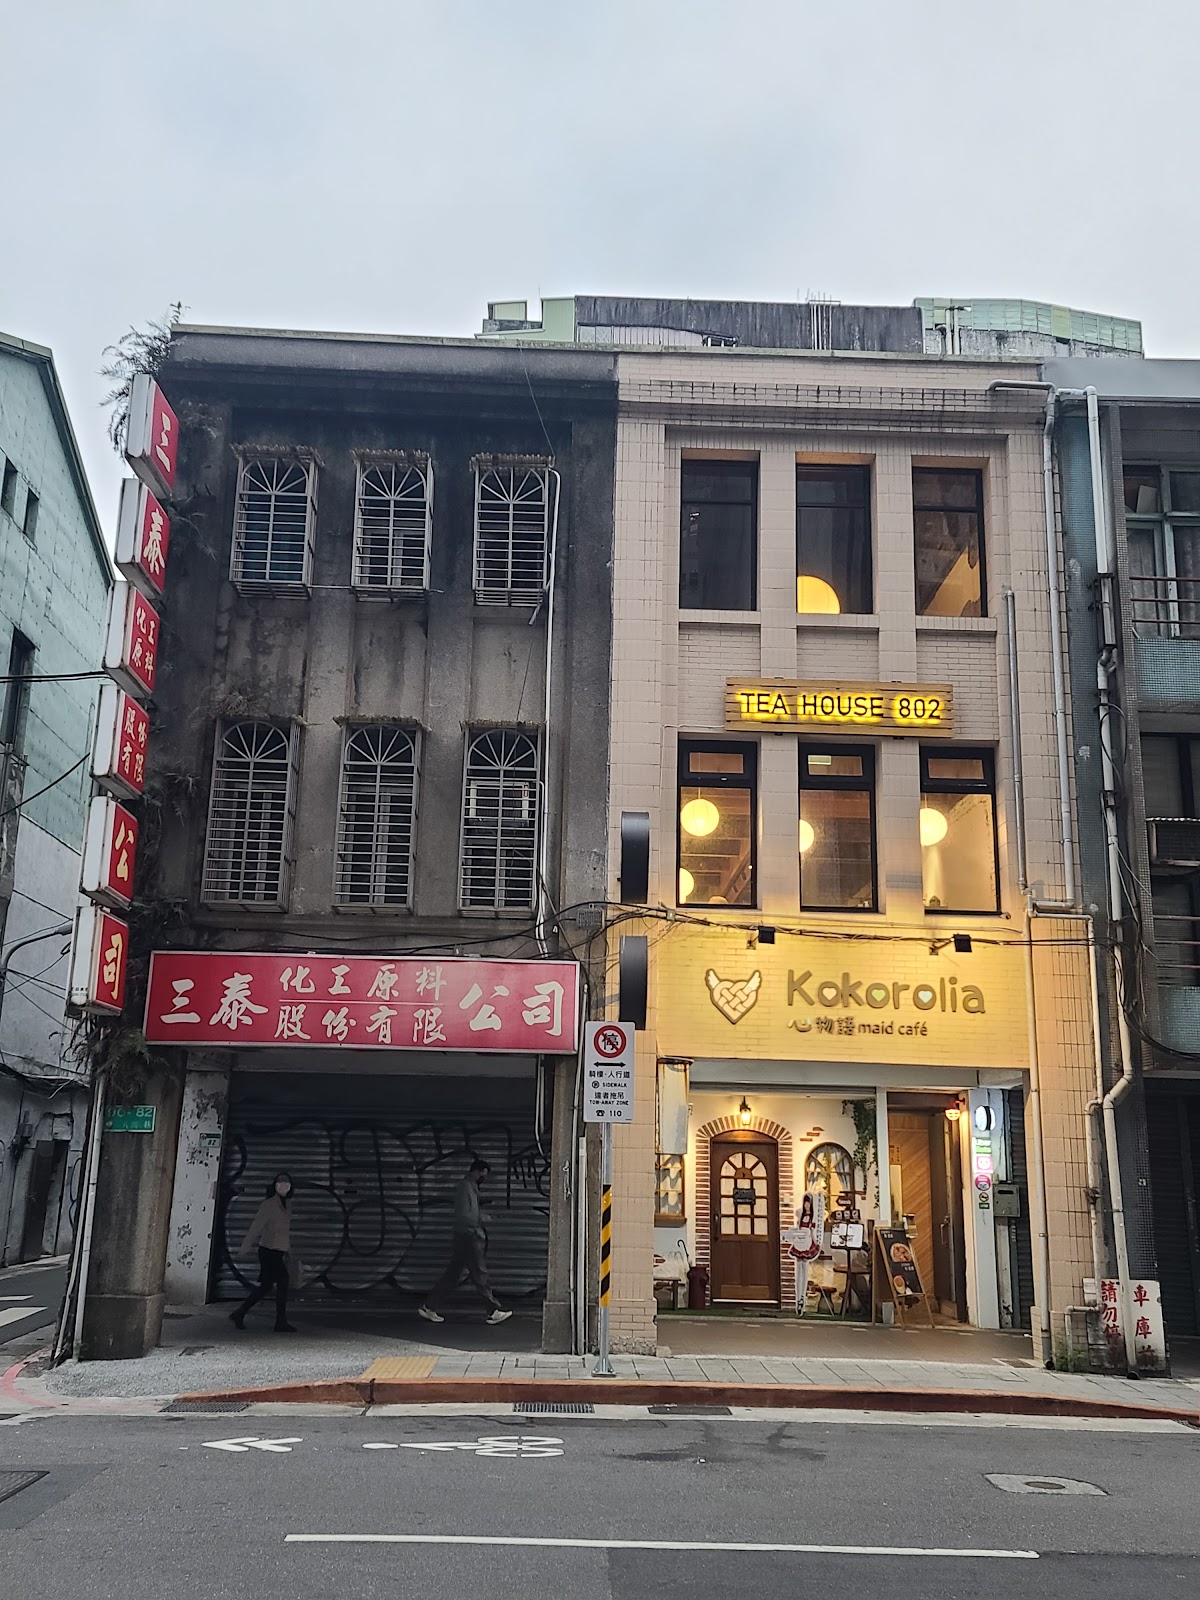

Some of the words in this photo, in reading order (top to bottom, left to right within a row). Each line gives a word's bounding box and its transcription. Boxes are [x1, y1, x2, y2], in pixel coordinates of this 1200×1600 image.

[740, 693, 790, 714] TEA
[803, 694, 884, 716] HOUSE
[899, 698, 941, 718] 802
[115, 821, 134, 882] 公
[103, 933, 122, 1000] 司
[279, 963, 447, 1001] 化工原料
[160, 972, 269, 1031] 三泰
[459, 981, 565, 1037] 公司
[787, 969, 986, 1014] Kokorolia
[274, 1004, 447, 1045] 股份有限
[602, 1033, 619, 1051] 停
[857, 1020, 894, 1035] maid
[897, 1021, 928, 1037] café
